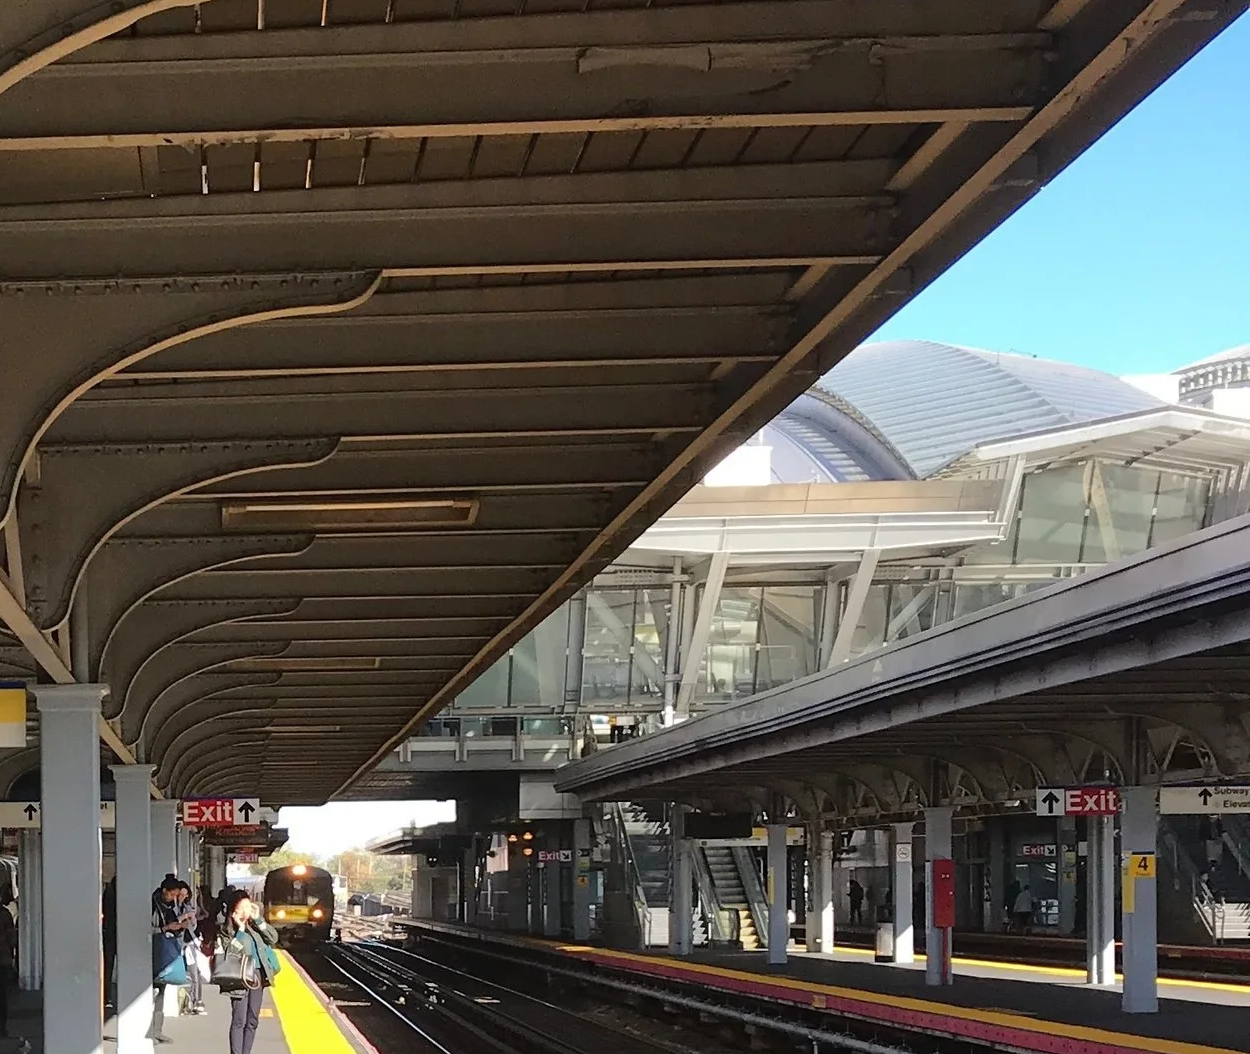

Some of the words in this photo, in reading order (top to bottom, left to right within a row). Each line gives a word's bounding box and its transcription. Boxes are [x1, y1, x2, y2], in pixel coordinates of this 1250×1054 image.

[1214, 787, 1249, 796] Subway
[1065, 790, 1116, 812] Exit
[183, 801, 232, 822] Exit
[538, 851, 559, 860] Exit
[1023, 846, 1044, 855] Exit
[1138, 857, 1148, 871] 4
